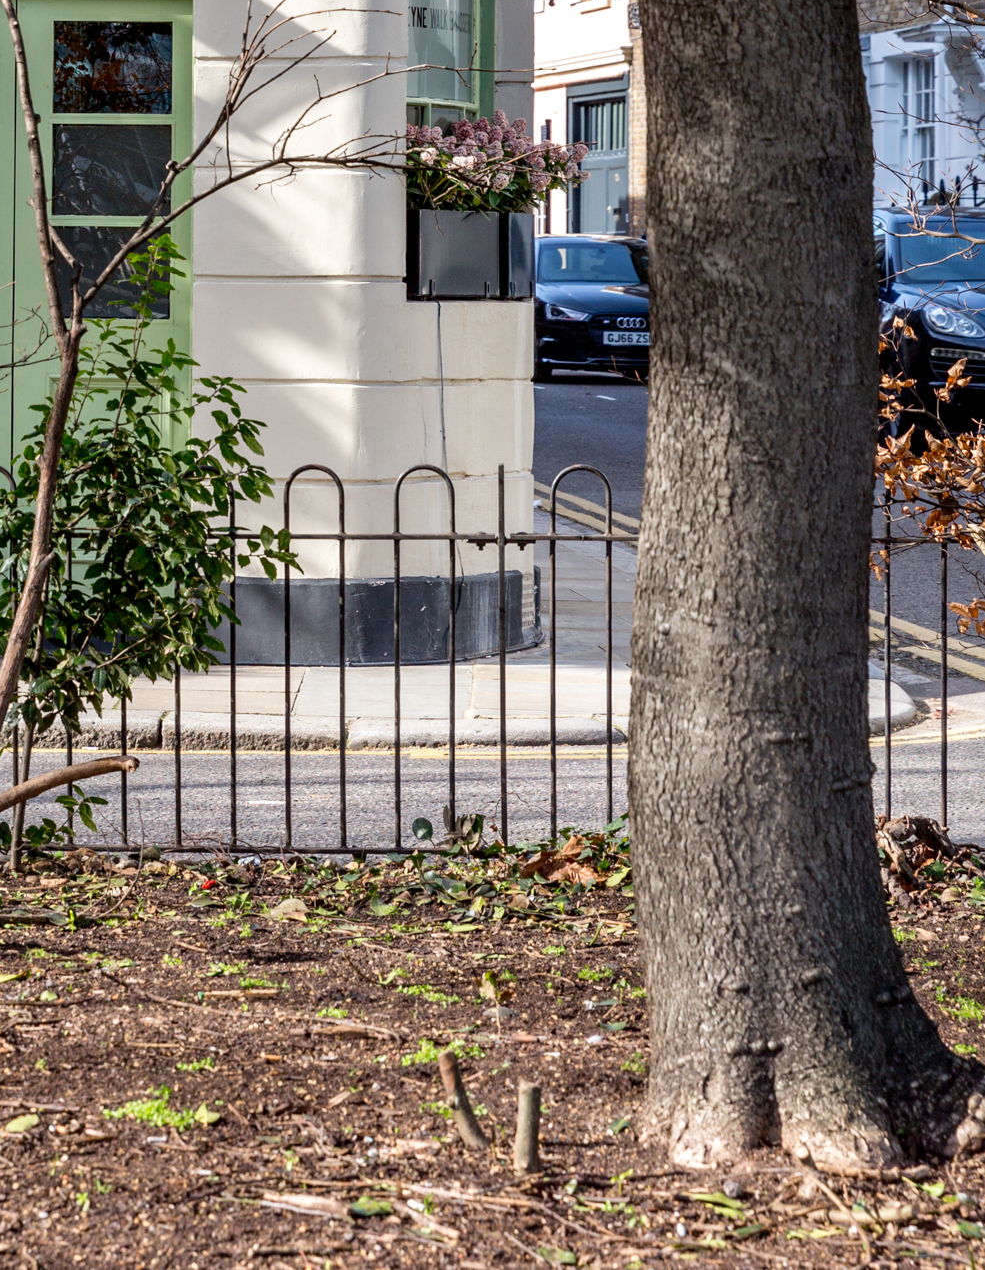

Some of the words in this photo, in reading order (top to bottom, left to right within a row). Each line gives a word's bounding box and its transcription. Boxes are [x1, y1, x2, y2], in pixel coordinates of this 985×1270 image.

[408, 6, 427, 29] YNE
[430, 8, 448, 30] WALK
[607, 333, 633, 343] GJ66
